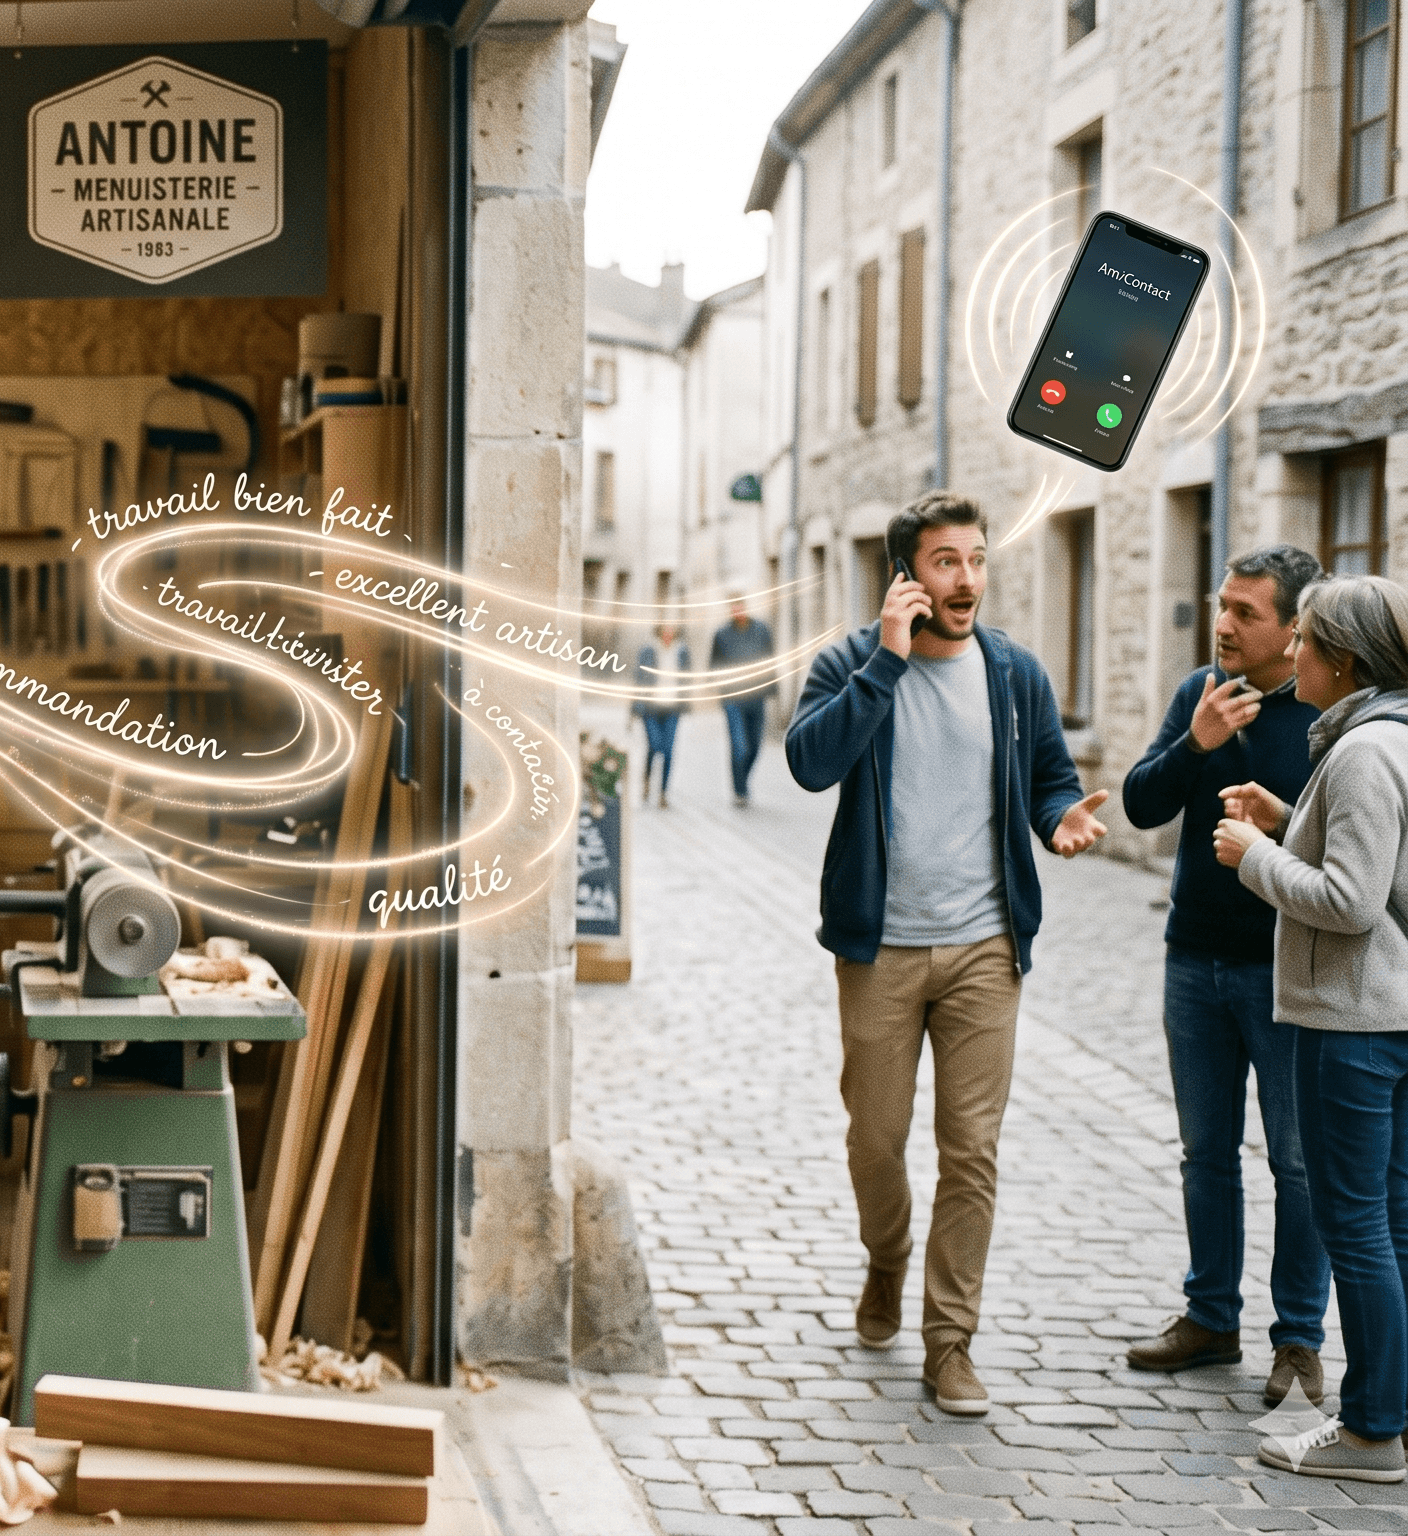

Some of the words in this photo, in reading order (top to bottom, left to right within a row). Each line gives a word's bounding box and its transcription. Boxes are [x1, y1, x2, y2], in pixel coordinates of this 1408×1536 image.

[55, 119, 257, 165] ANTOINE
[74, 176, 236, 201] MENUISTERIE
[81, 207, 230, 232] ARTISANALE
[137, 242, 174, 257] 1983
